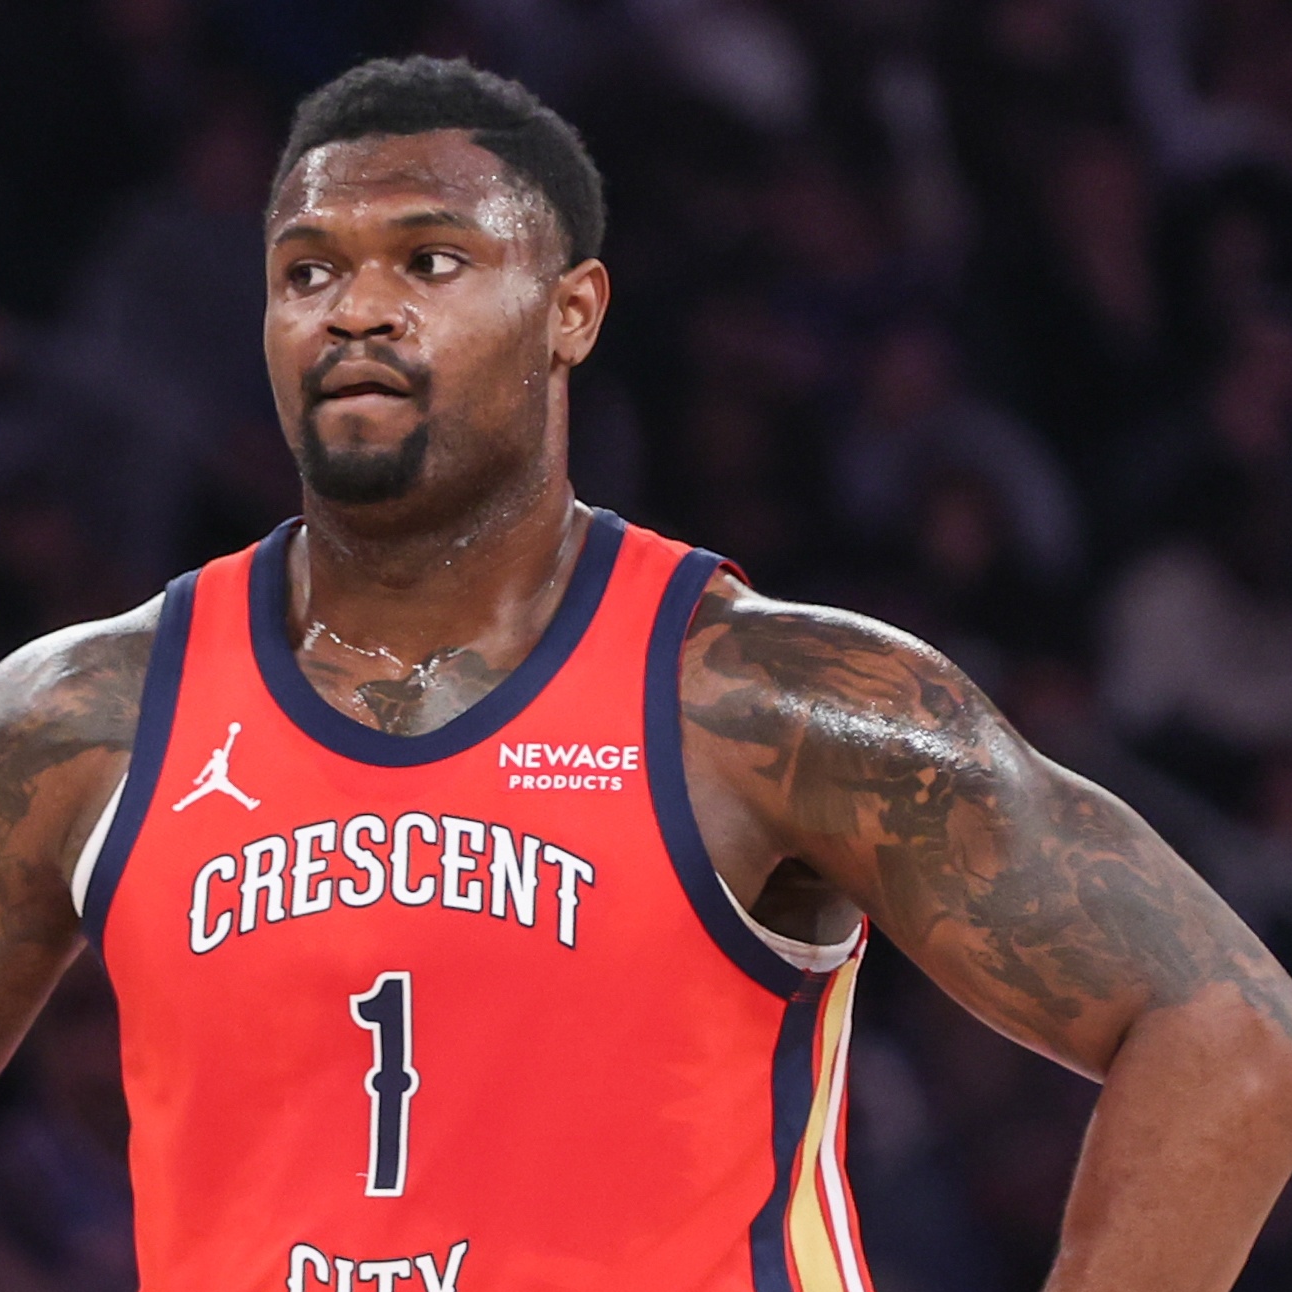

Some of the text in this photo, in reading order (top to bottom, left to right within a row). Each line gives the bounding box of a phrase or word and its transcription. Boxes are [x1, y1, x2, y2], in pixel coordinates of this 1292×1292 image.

[498, 742, 640, 771] NEWAGE
[508, 773, 623, 791] PRODUCTS
[187, 811, 594, 955] CRESCENT
[349, 970, 420, 1198] 1
